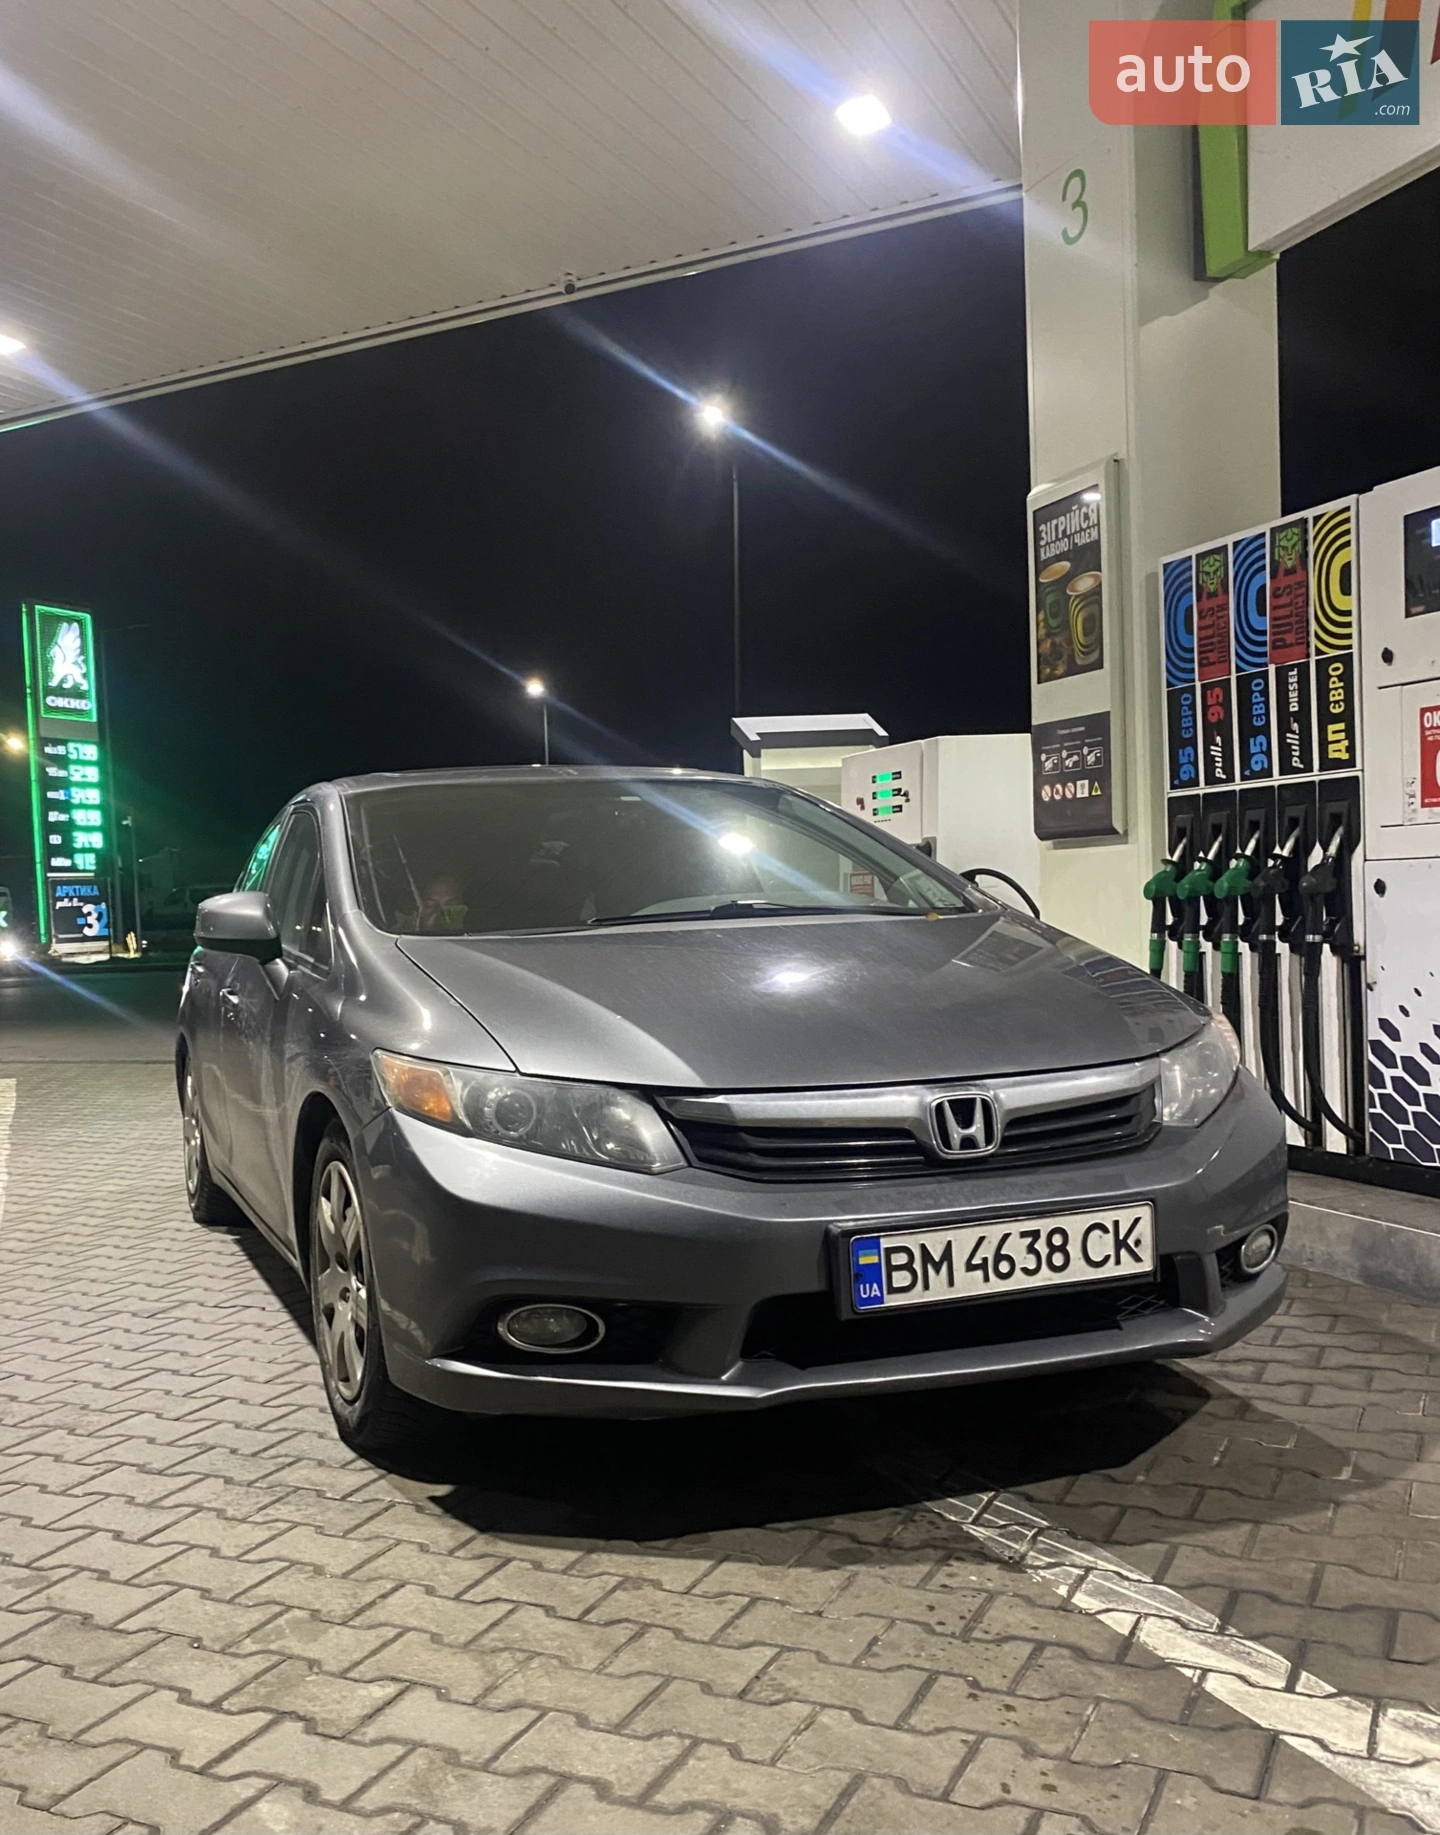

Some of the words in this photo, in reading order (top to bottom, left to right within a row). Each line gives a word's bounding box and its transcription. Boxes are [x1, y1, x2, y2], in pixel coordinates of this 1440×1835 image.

[1061, 168, 1089, 246] 3
[1039, 502, 1098, 546] ЗІГРІЙСЯ
[1040, 537, 1069, 561] КАВОЮ
[1199, 606, 1216, 667] PULLS
[1272, 584, 1295, 651] PULLS
[1207, 687, 1224, 723] 95
[1251, 678, 1266, 726] ЄВРО
[1288, 667, 1299, 712] DIESEL
[1328, 662, 1345, 714] ЄВРО
[1181, 693, 1194, 738] ЄВРО
[1210, 733, 1227, 779] pulls
[1286, 721, 1304, 769] pulls
[1327, 722, 1350, 760] ДП
[55, 885, 100, 898] АРКТИКА
[883, 1239, 955, 1296] BM
[965, 1226, 1071, 1284] 4638
[1081, 1216, 1144, 1269] CK
[860, 1282, 881, 1299] UA
